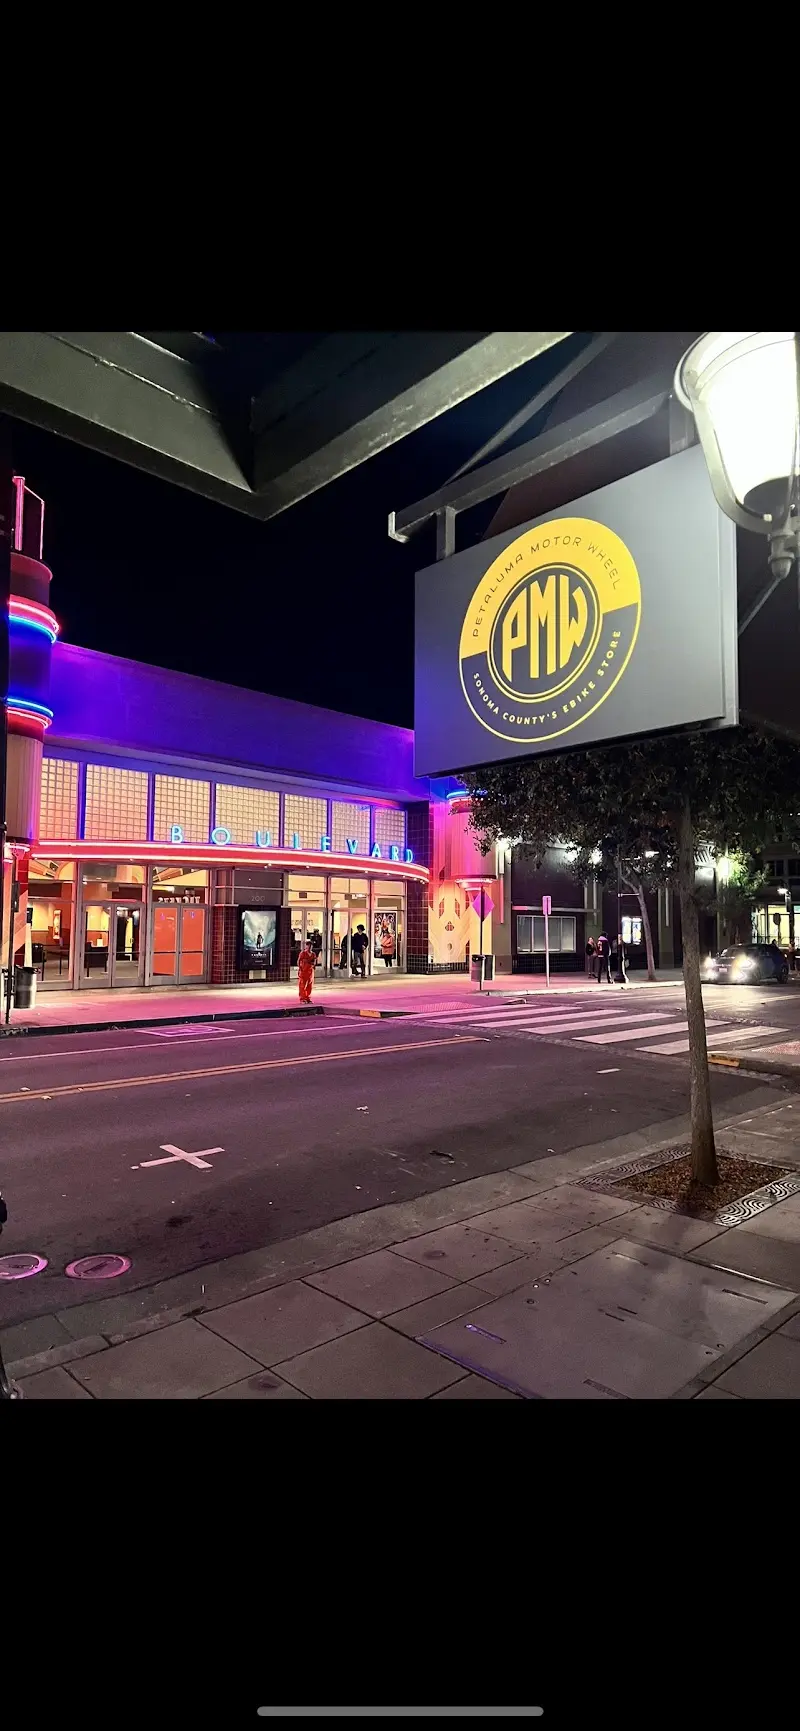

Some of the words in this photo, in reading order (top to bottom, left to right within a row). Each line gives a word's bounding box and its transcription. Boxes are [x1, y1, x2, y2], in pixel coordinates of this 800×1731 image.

[472, 553, 524, 638] PETALUMA
[530, 535, 582, 554] MOTOR
[588, 541, 621, 590] WHEEL
[502, 574, 588, 682] PMW
[473, 672, 500, 714] SONOMA
[502, 710, 558, 725] COUNTY'S
[563, 681, 596, 713] EBIKE
[597, 630, 621, 676] STORE
[170, 825, 413, 863] BOULEVARD
